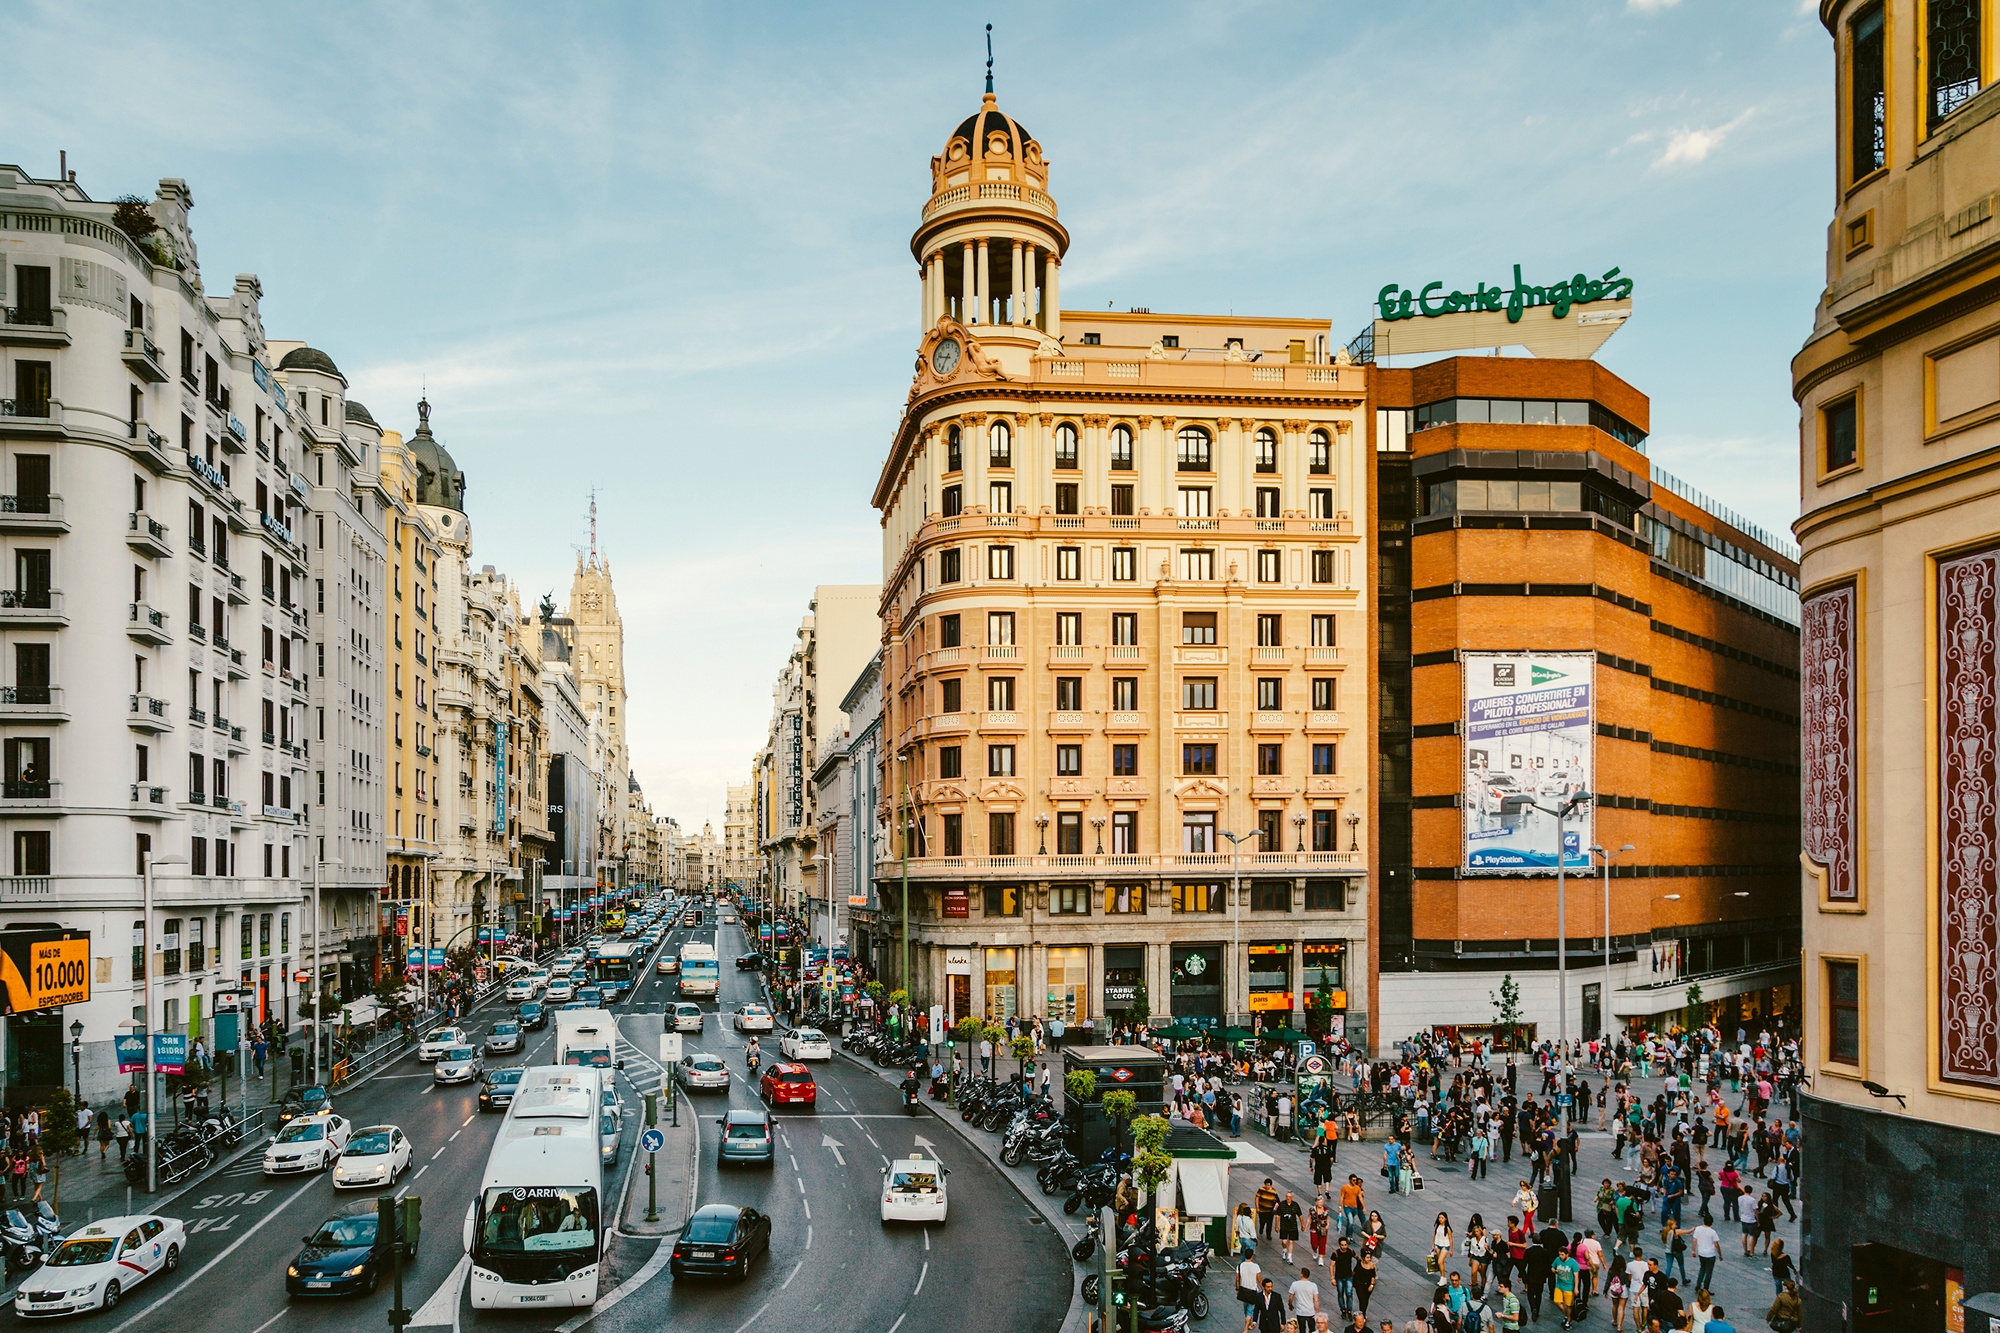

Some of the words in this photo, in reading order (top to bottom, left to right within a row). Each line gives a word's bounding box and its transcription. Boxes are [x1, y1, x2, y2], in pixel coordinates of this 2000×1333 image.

[1378, 283, 1414, 321] El
[1419, 281, 1502, 317] Corte
[1507, 264, 1633, 323] Inglés
[195, 454, 228, 491] HOSTAL
[264, 513, 293, 545] JOSEFINA
[1472, 696, 1514, 713] ¿QUIERES
[1515, 688, 1572, 705] CONVERTIRTE
[1573, 686, 1586, 697] EN
[1484, 707, 1513, 719] PILOTO
[1515, 698, 1577, 715] PROFESIONAL?
[1477, 722, 1505, 732] ESPERAMOS
[1519, 717, 1542, 726] ESPACIO
[1542, 715, 1550, 723] DE
[1551, 710, 1587, 721] VIDEOJUEGOS
[1508, 727, 1523, 735] CORTE
[1523, 724, 1540, 733] INGLÉS
[1547, 721, 1565, 729] CALLAO
[1485, 856, 1524, 865] PlayStation
[39, 947, 52, 959] MÁS
[53, 948, 61, 958] DE
[36, 960, 84, 991] 10.000
[39, 991, 84, 1007] ESPECTADORES
[162, 1037, 179, 1045] SAN
[157, 1047, 184, 1055] ISIDRO
[1302, 1045, 1312, 1056] P
[192, 1189, 274, 1210] BUS
[527, 1188, 568, 1198] ARRIVA
